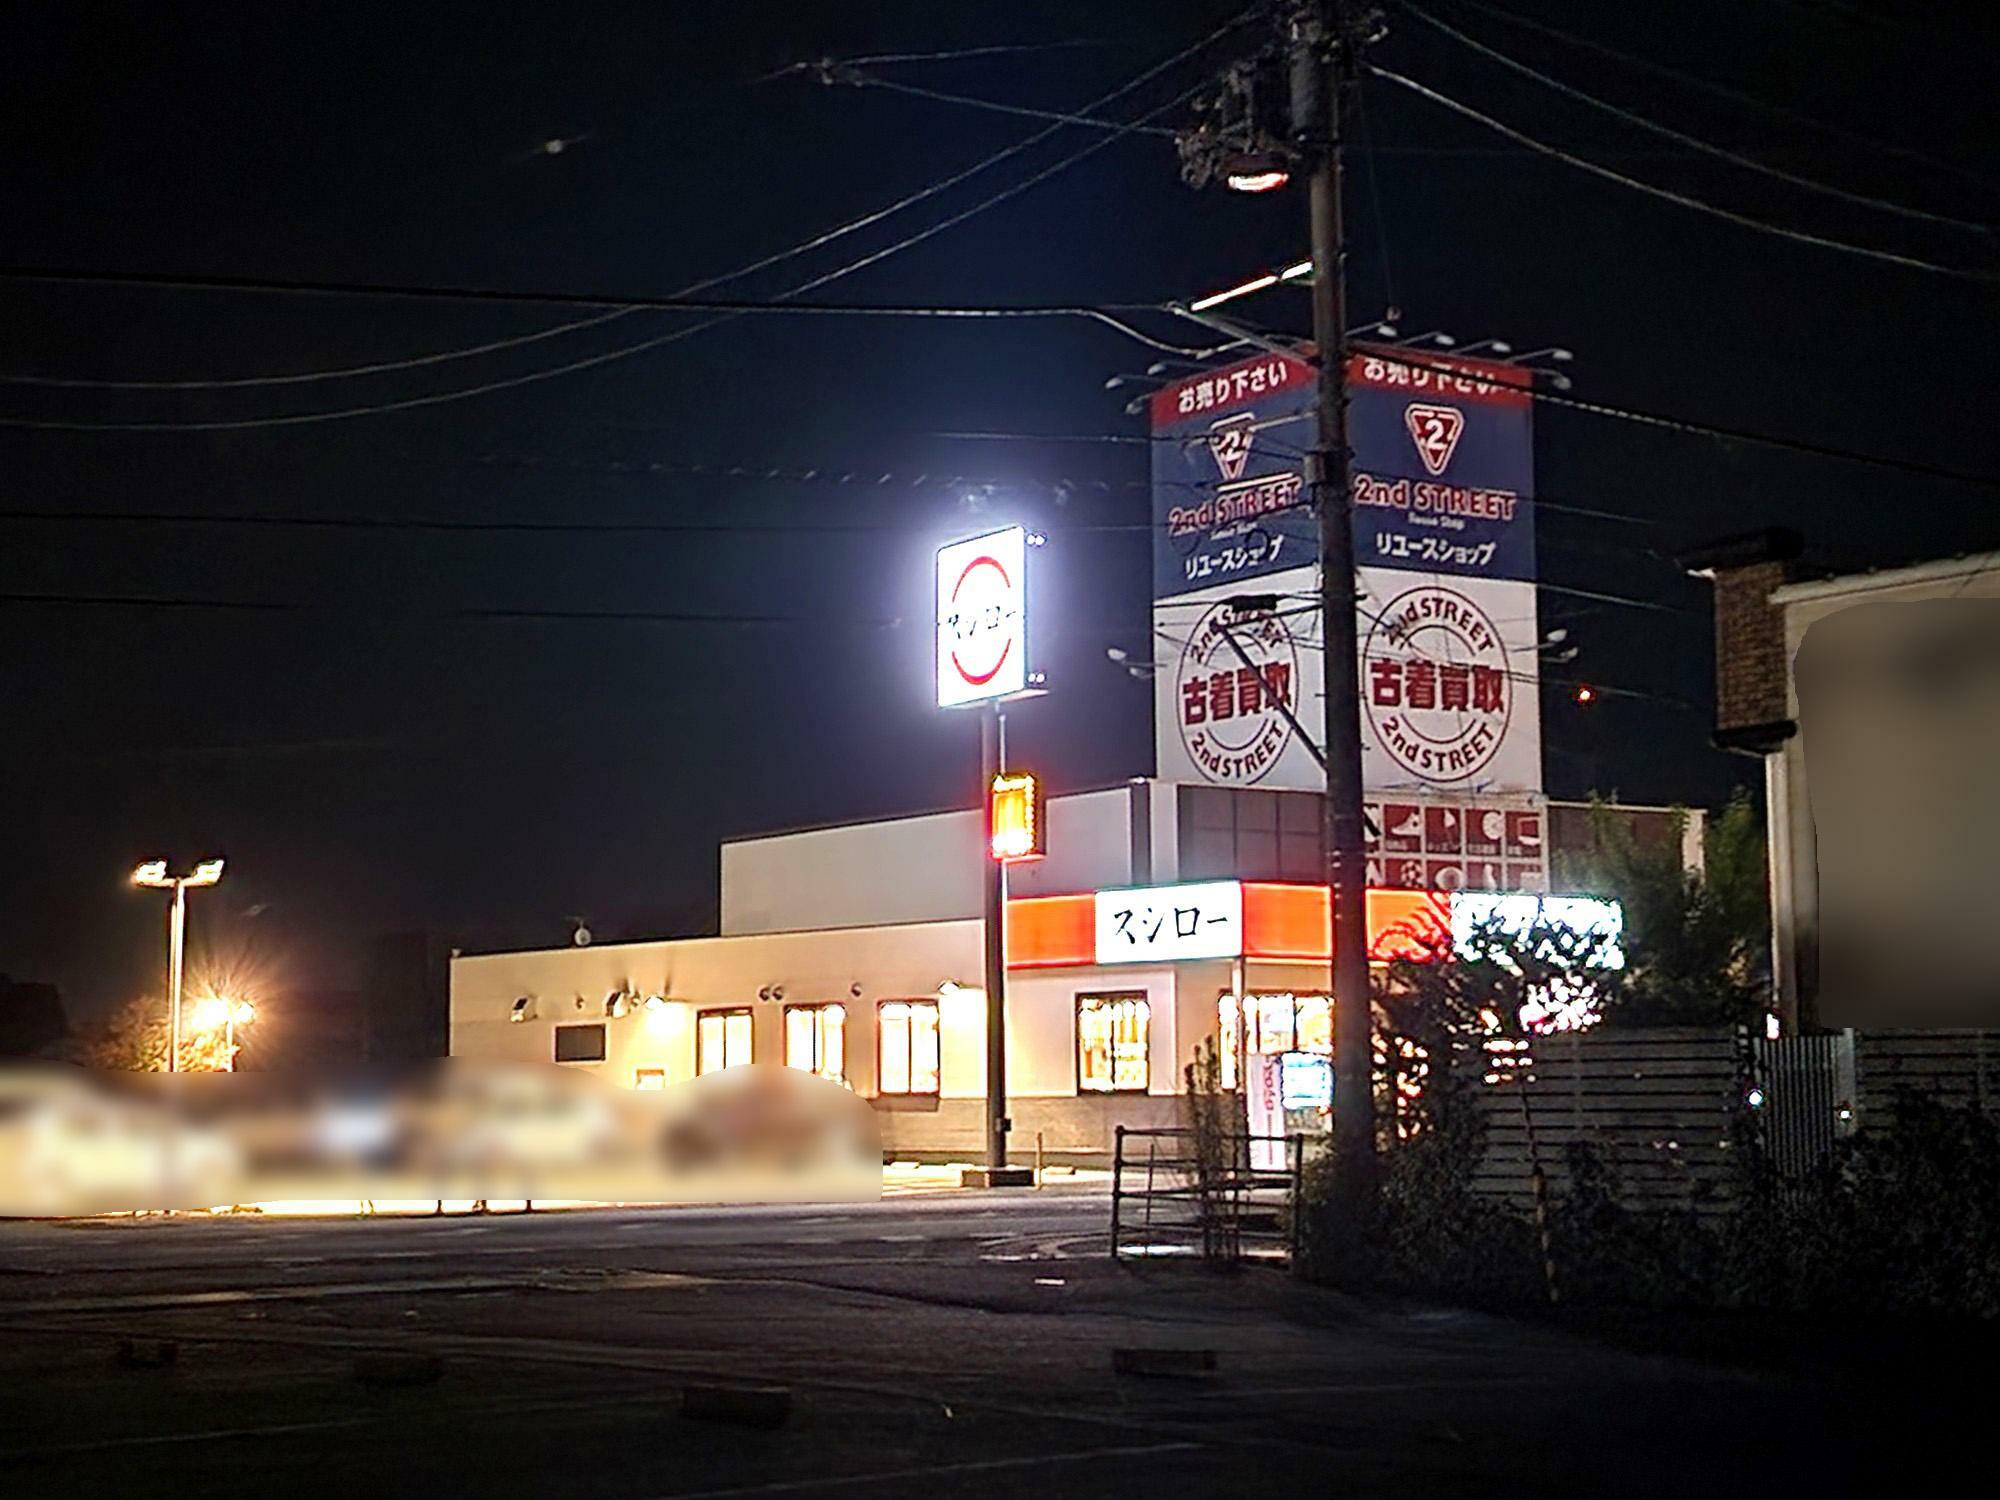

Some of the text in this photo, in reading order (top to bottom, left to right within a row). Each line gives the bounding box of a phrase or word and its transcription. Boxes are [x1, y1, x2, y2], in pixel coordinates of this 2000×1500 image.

[1178, 361, 1288, 414] お売り下さい
[1424, 418, 1448, 450] 2
[1168, 506, 1212, 540] 2nd
[1214, 476, 1304, 527] STREET
[1354, 473, 1517, 521] 2nd STREET
[1376, 531, 1497, 566] リユースショップ
[1182, 660, 1292, 727] 古着買取
[1370, 657, 1504, 714] 古着買取
[1113, 907, 1228, 945] スシロー
